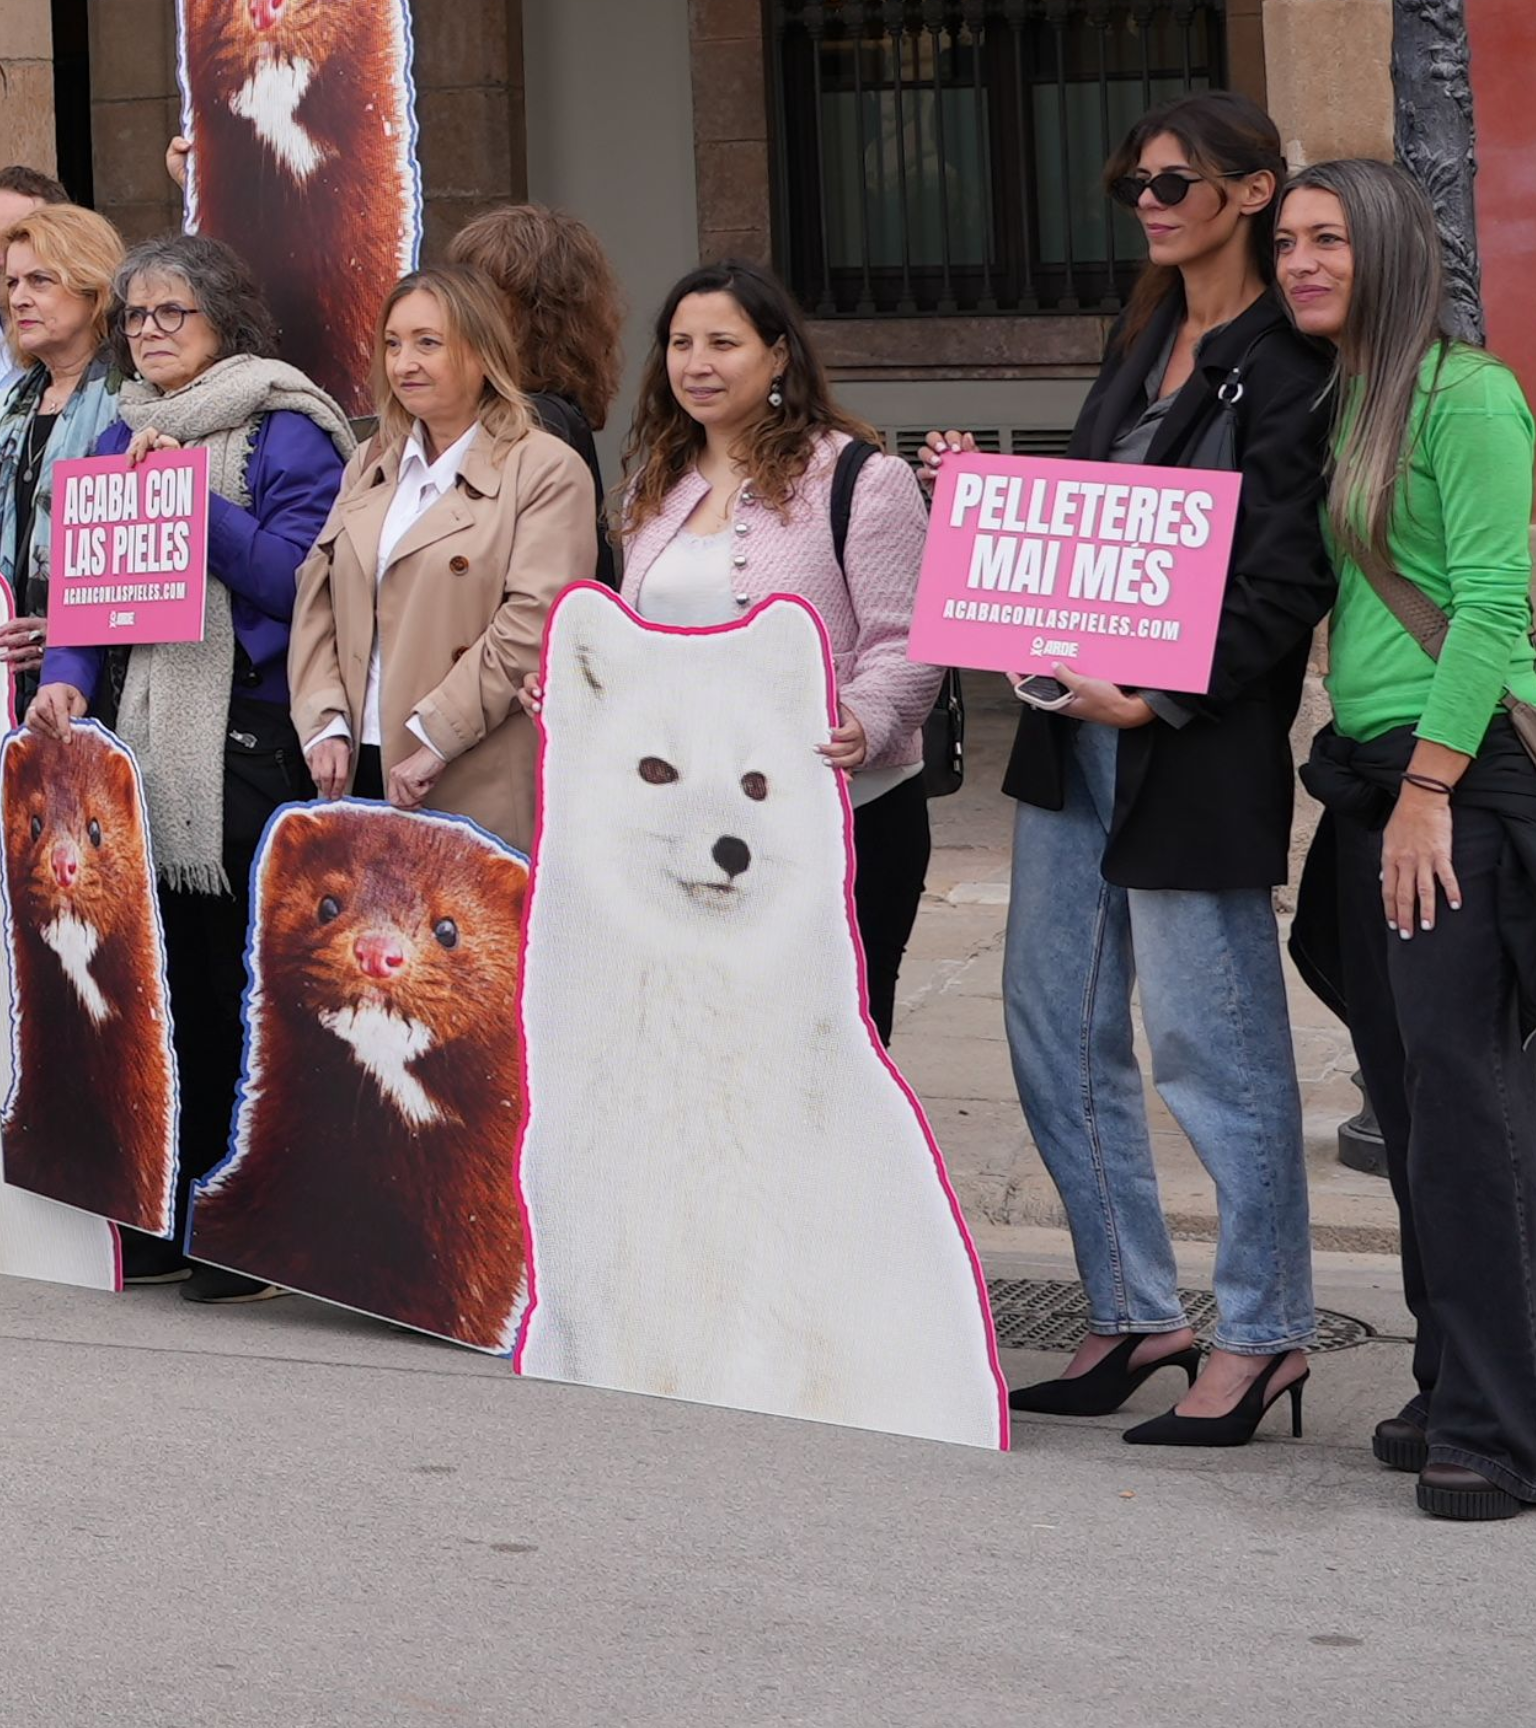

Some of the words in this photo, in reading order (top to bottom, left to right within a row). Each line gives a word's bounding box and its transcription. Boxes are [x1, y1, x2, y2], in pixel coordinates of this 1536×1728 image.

[63, 472, 138, 525] ACABA
[146, 467, 193, 519] CON
[950, 473, 1214, 549] PELLETERES
[64, 527, 106, 577] LAS
[112, 521, 190, 575] PIELES
[967, 534, 1061, 595] MAI
[1068, 542, 1174, 607] MÉS
[943, 599, 1180, 641] ACABACONLASPIELES.COM
[1043, 640, 1079, 657] ARDE
